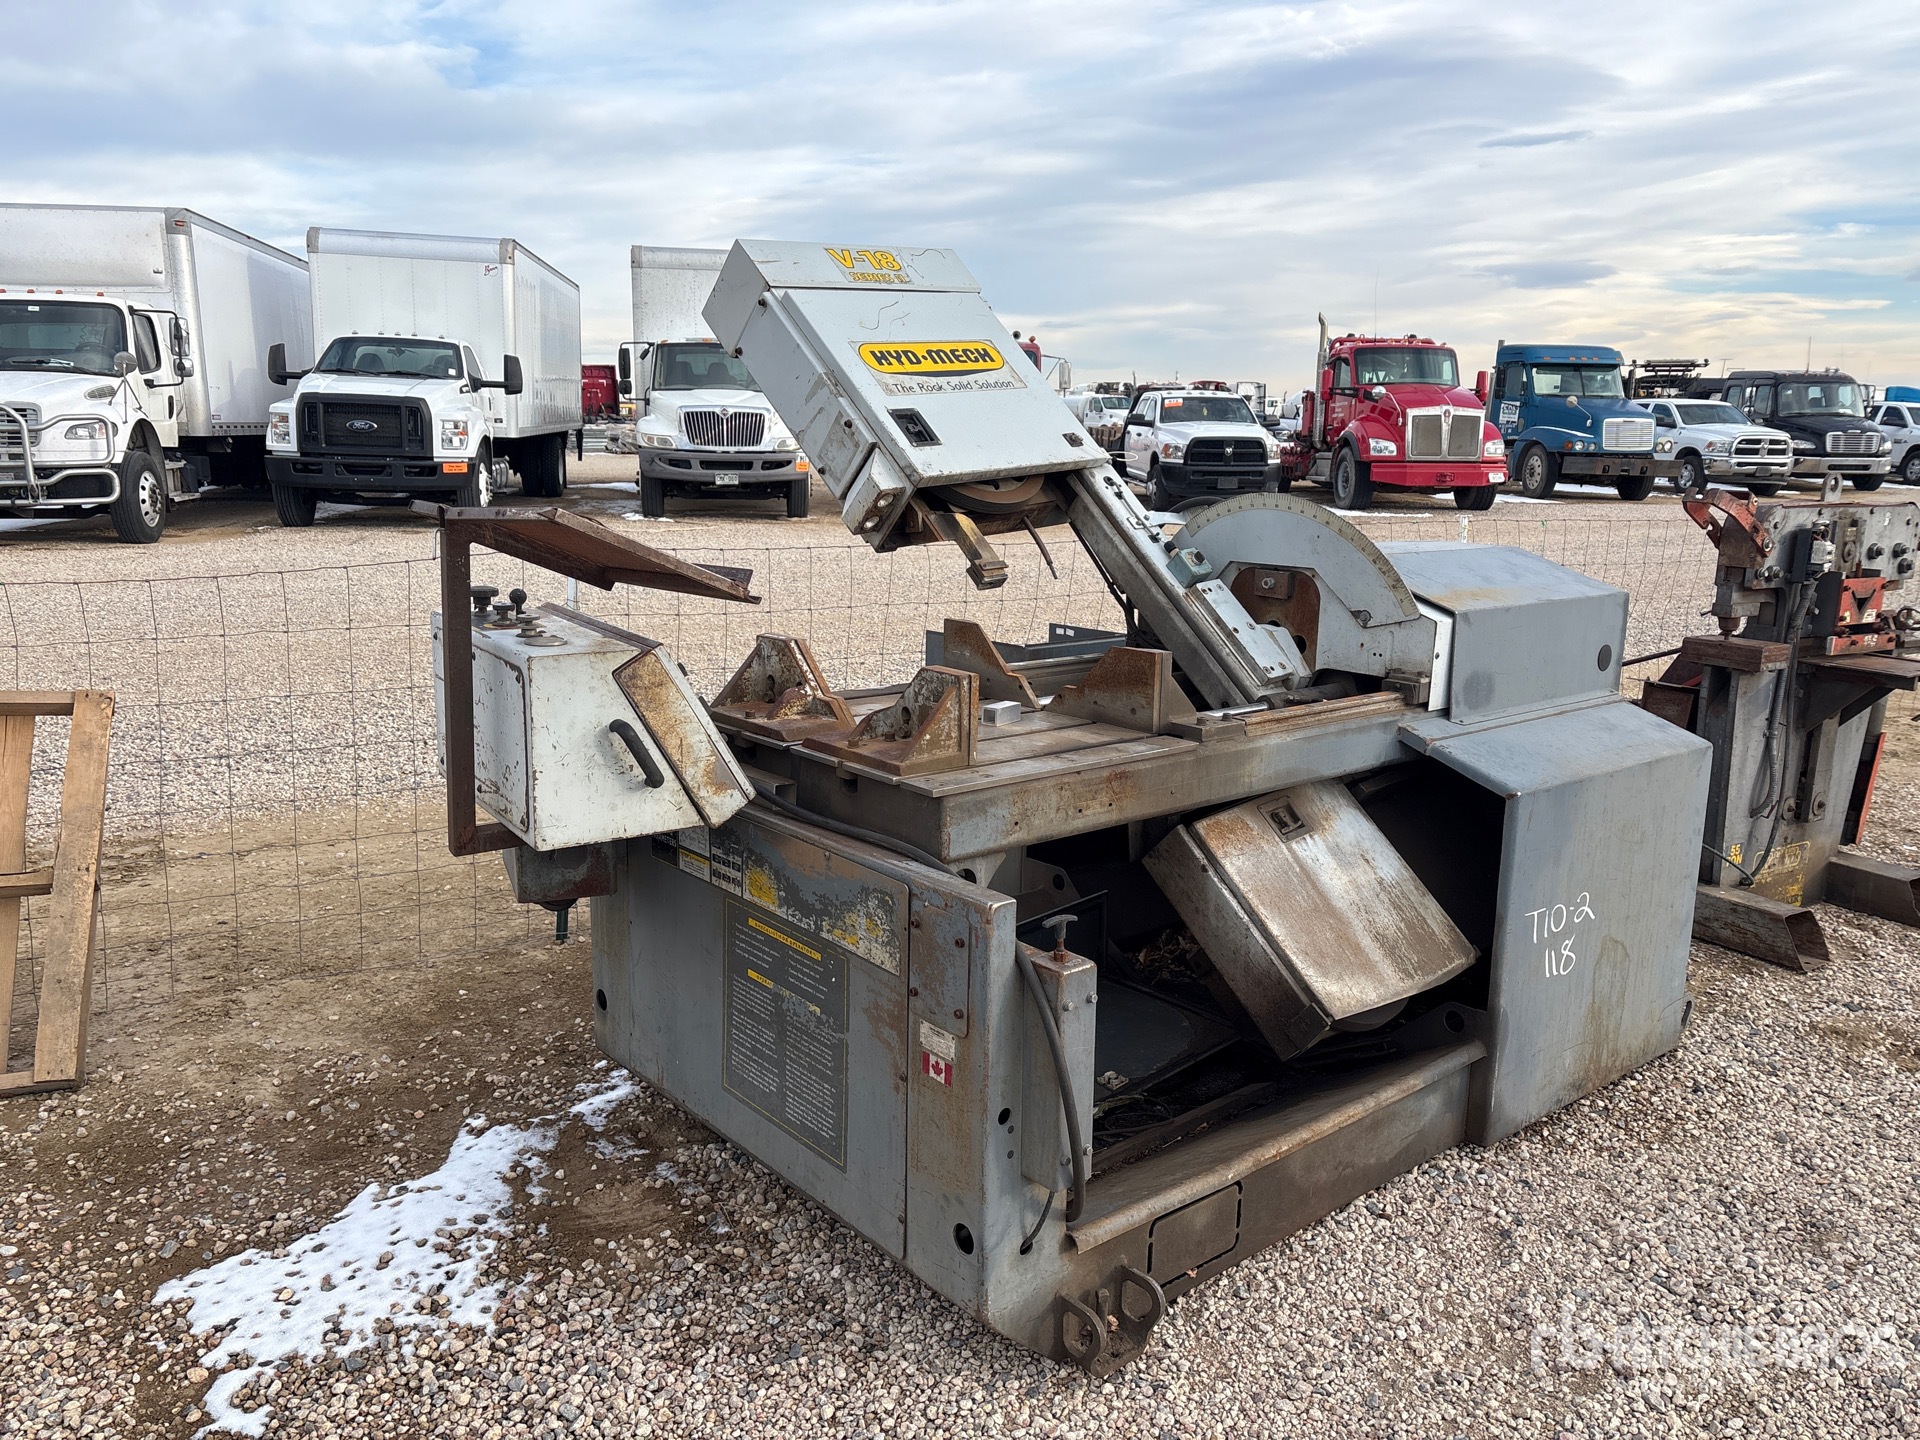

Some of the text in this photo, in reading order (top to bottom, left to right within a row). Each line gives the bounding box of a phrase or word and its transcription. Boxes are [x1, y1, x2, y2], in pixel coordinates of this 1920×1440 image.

[825, 248, 902, 271] V-18
[849, 272, 894, 283] SERIES
[892, 380, 1015, 394] The Rock Solid Solution
[1730, 844, 1741, 856] 55
[1545, 934, 1577, 978] 118
